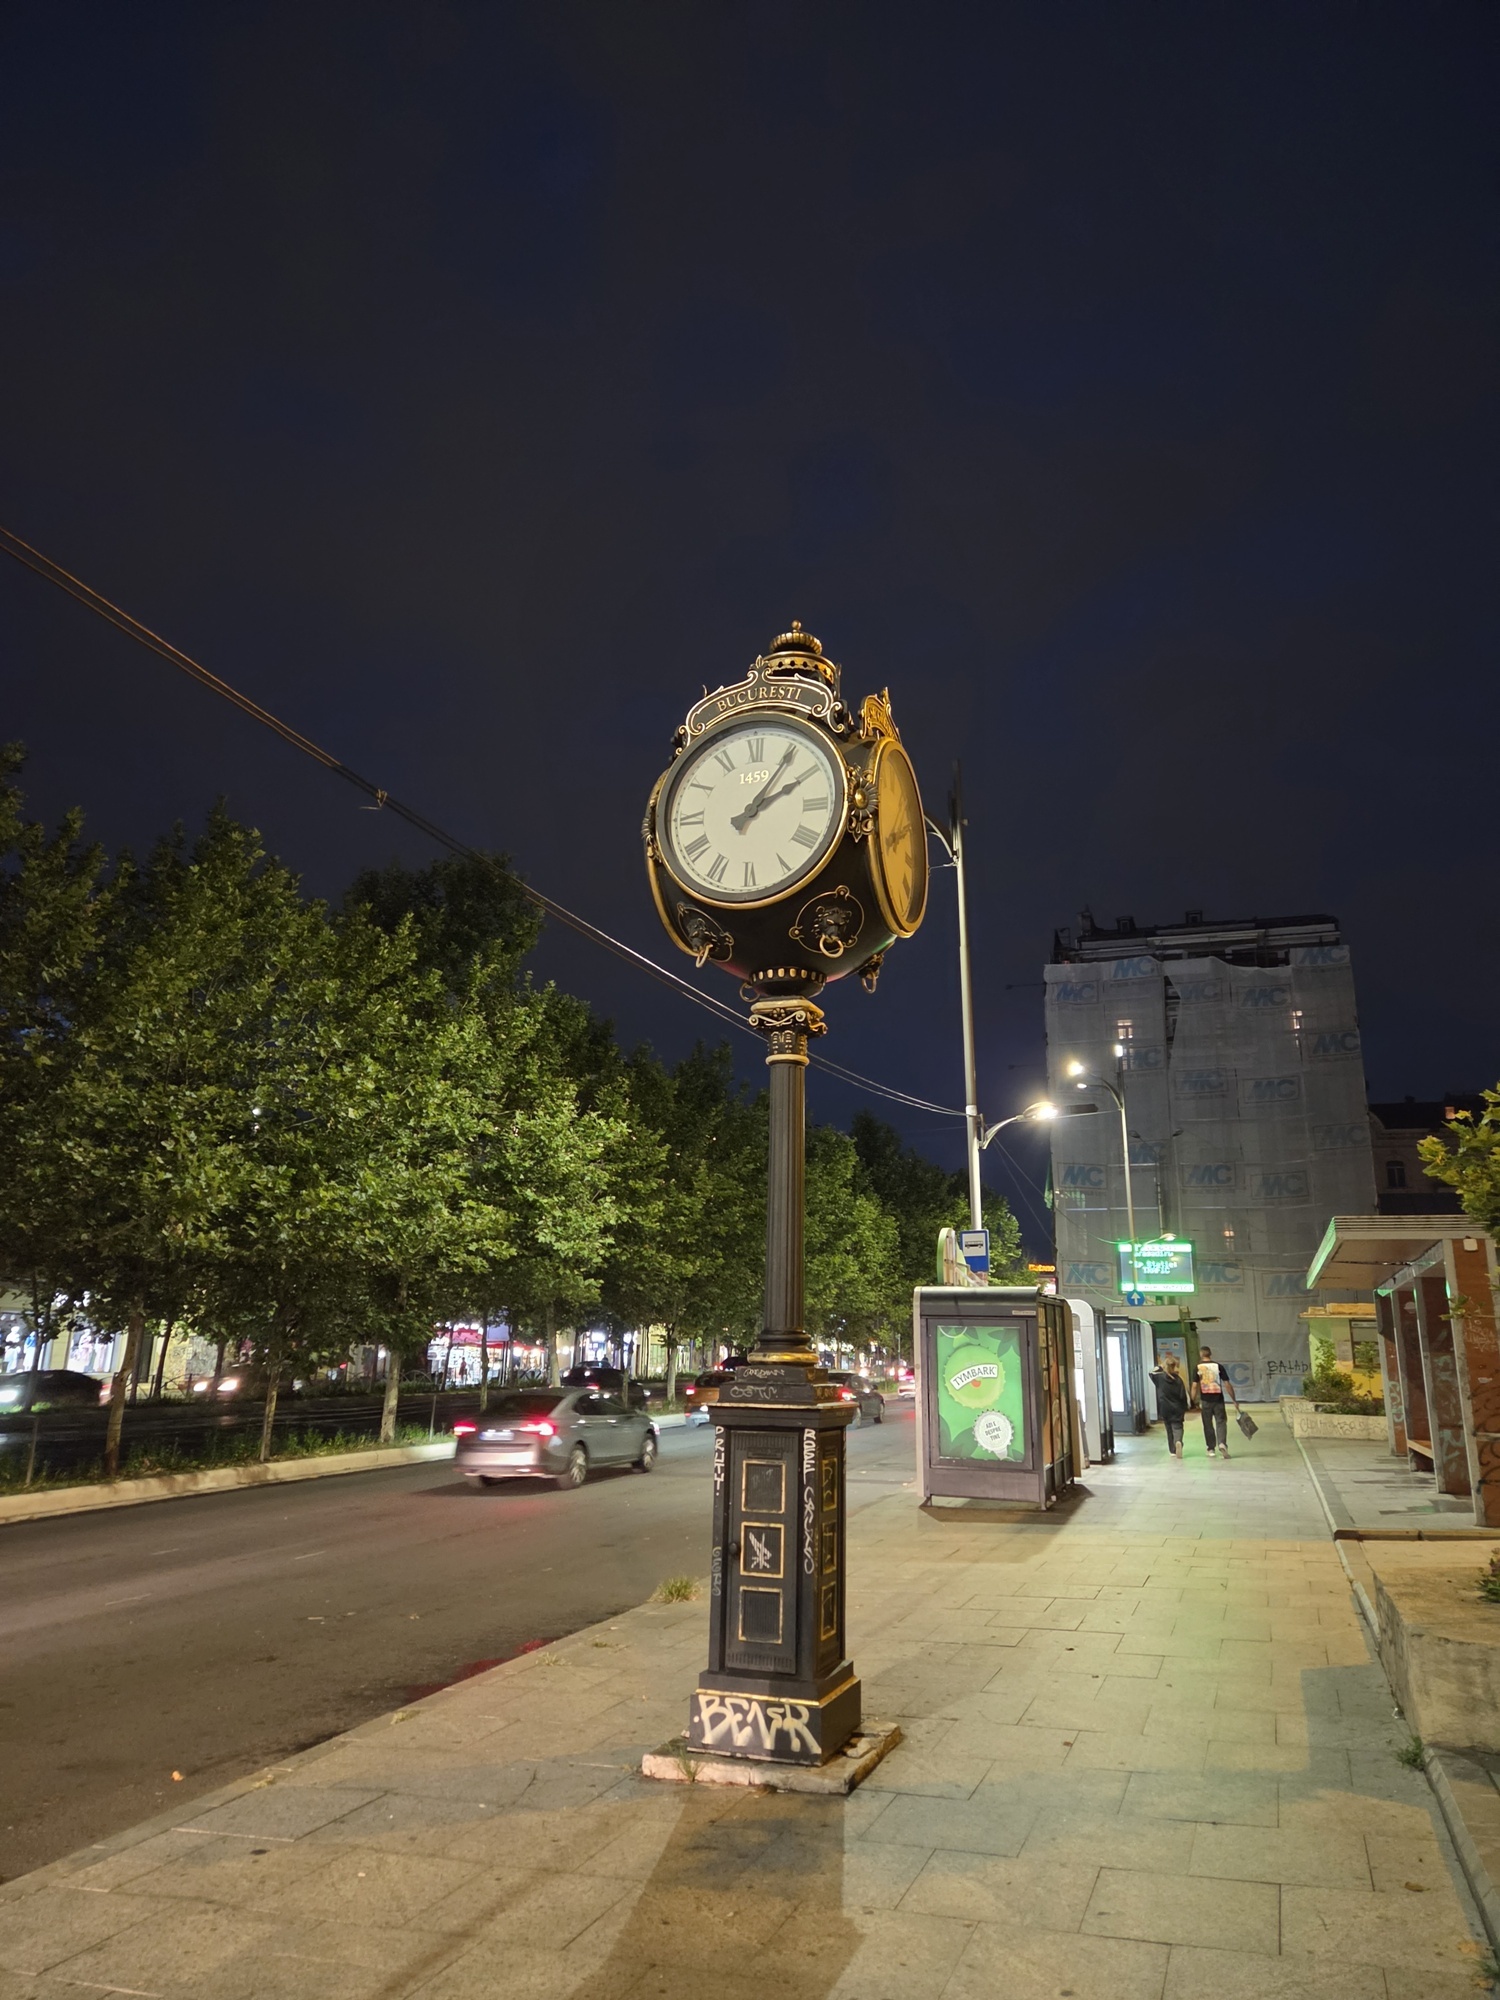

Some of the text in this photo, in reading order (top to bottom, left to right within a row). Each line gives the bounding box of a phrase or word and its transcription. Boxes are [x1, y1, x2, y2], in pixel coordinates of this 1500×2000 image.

[712, 747, 737, 778] XI
[746, 737, 766, 765] XII
[688, 776, 716, 799] X
[739, 769, 769, 785] 1459
[802, 793, 829, 814] III
[679, 807, 706, 830] IX
[683, 831, 712, 866] VIII
[704, 852, 731, 885] VII
[741, 861, 761, 888] VI
[776, 852, 796, 876] V
[1113, 957, 1155, 979] MC
[1056, 981, 1095, 1001] MC
[1240, 987, 1289, 1008] MC
[1312, 1032, 1360, 1054] MC
[1061, 1166, 1104, 1187] MC
[1187, 1164, 1233, 1185] MC
[1066, 1263, 1109, 1286] MC
[953, 1366, 996, 1386] TYMBARK
[1224, 1363, 1250, 1387] C
